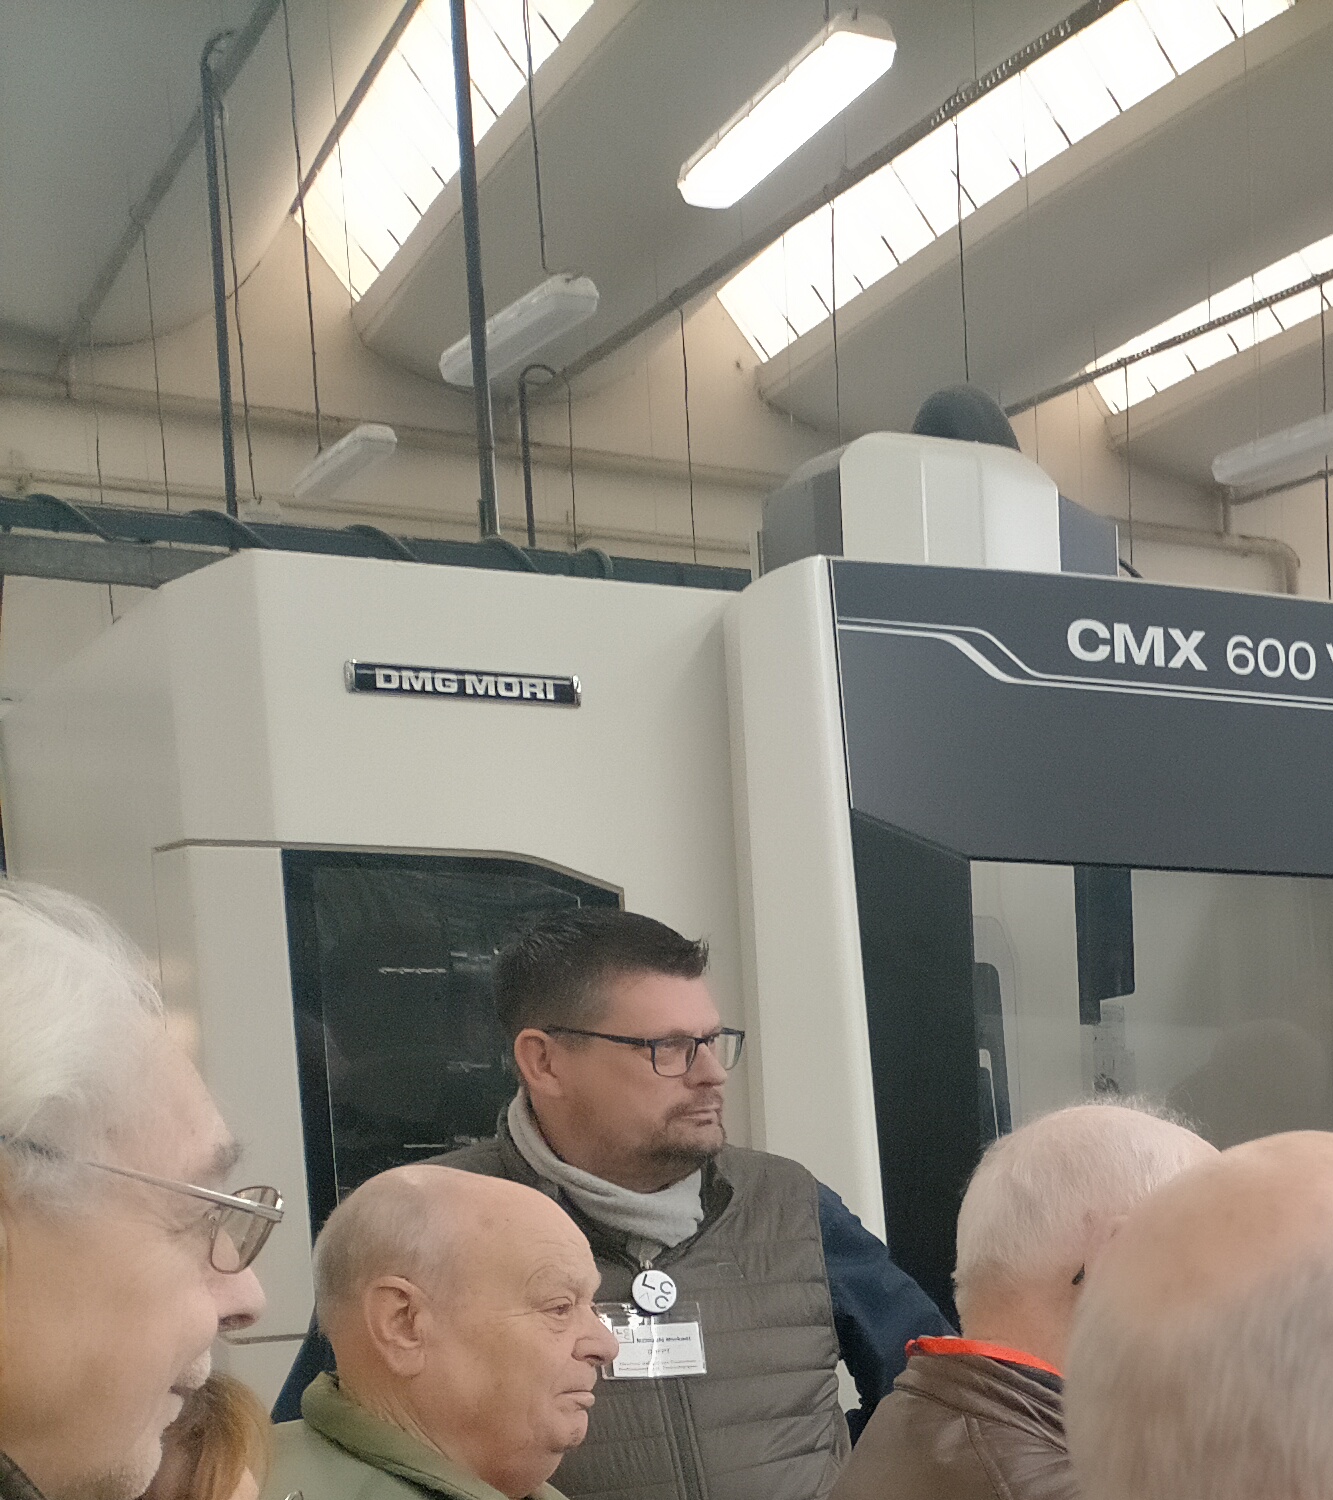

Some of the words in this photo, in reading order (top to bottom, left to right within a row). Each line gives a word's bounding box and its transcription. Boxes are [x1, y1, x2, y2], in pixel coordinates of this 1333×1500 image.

[1066, 618, 1208, 671] CMX
[1226, 635, 1317, 681] 600
[375, 667, 459, 694] DMG
[464, 673, 555, 700] MORI
